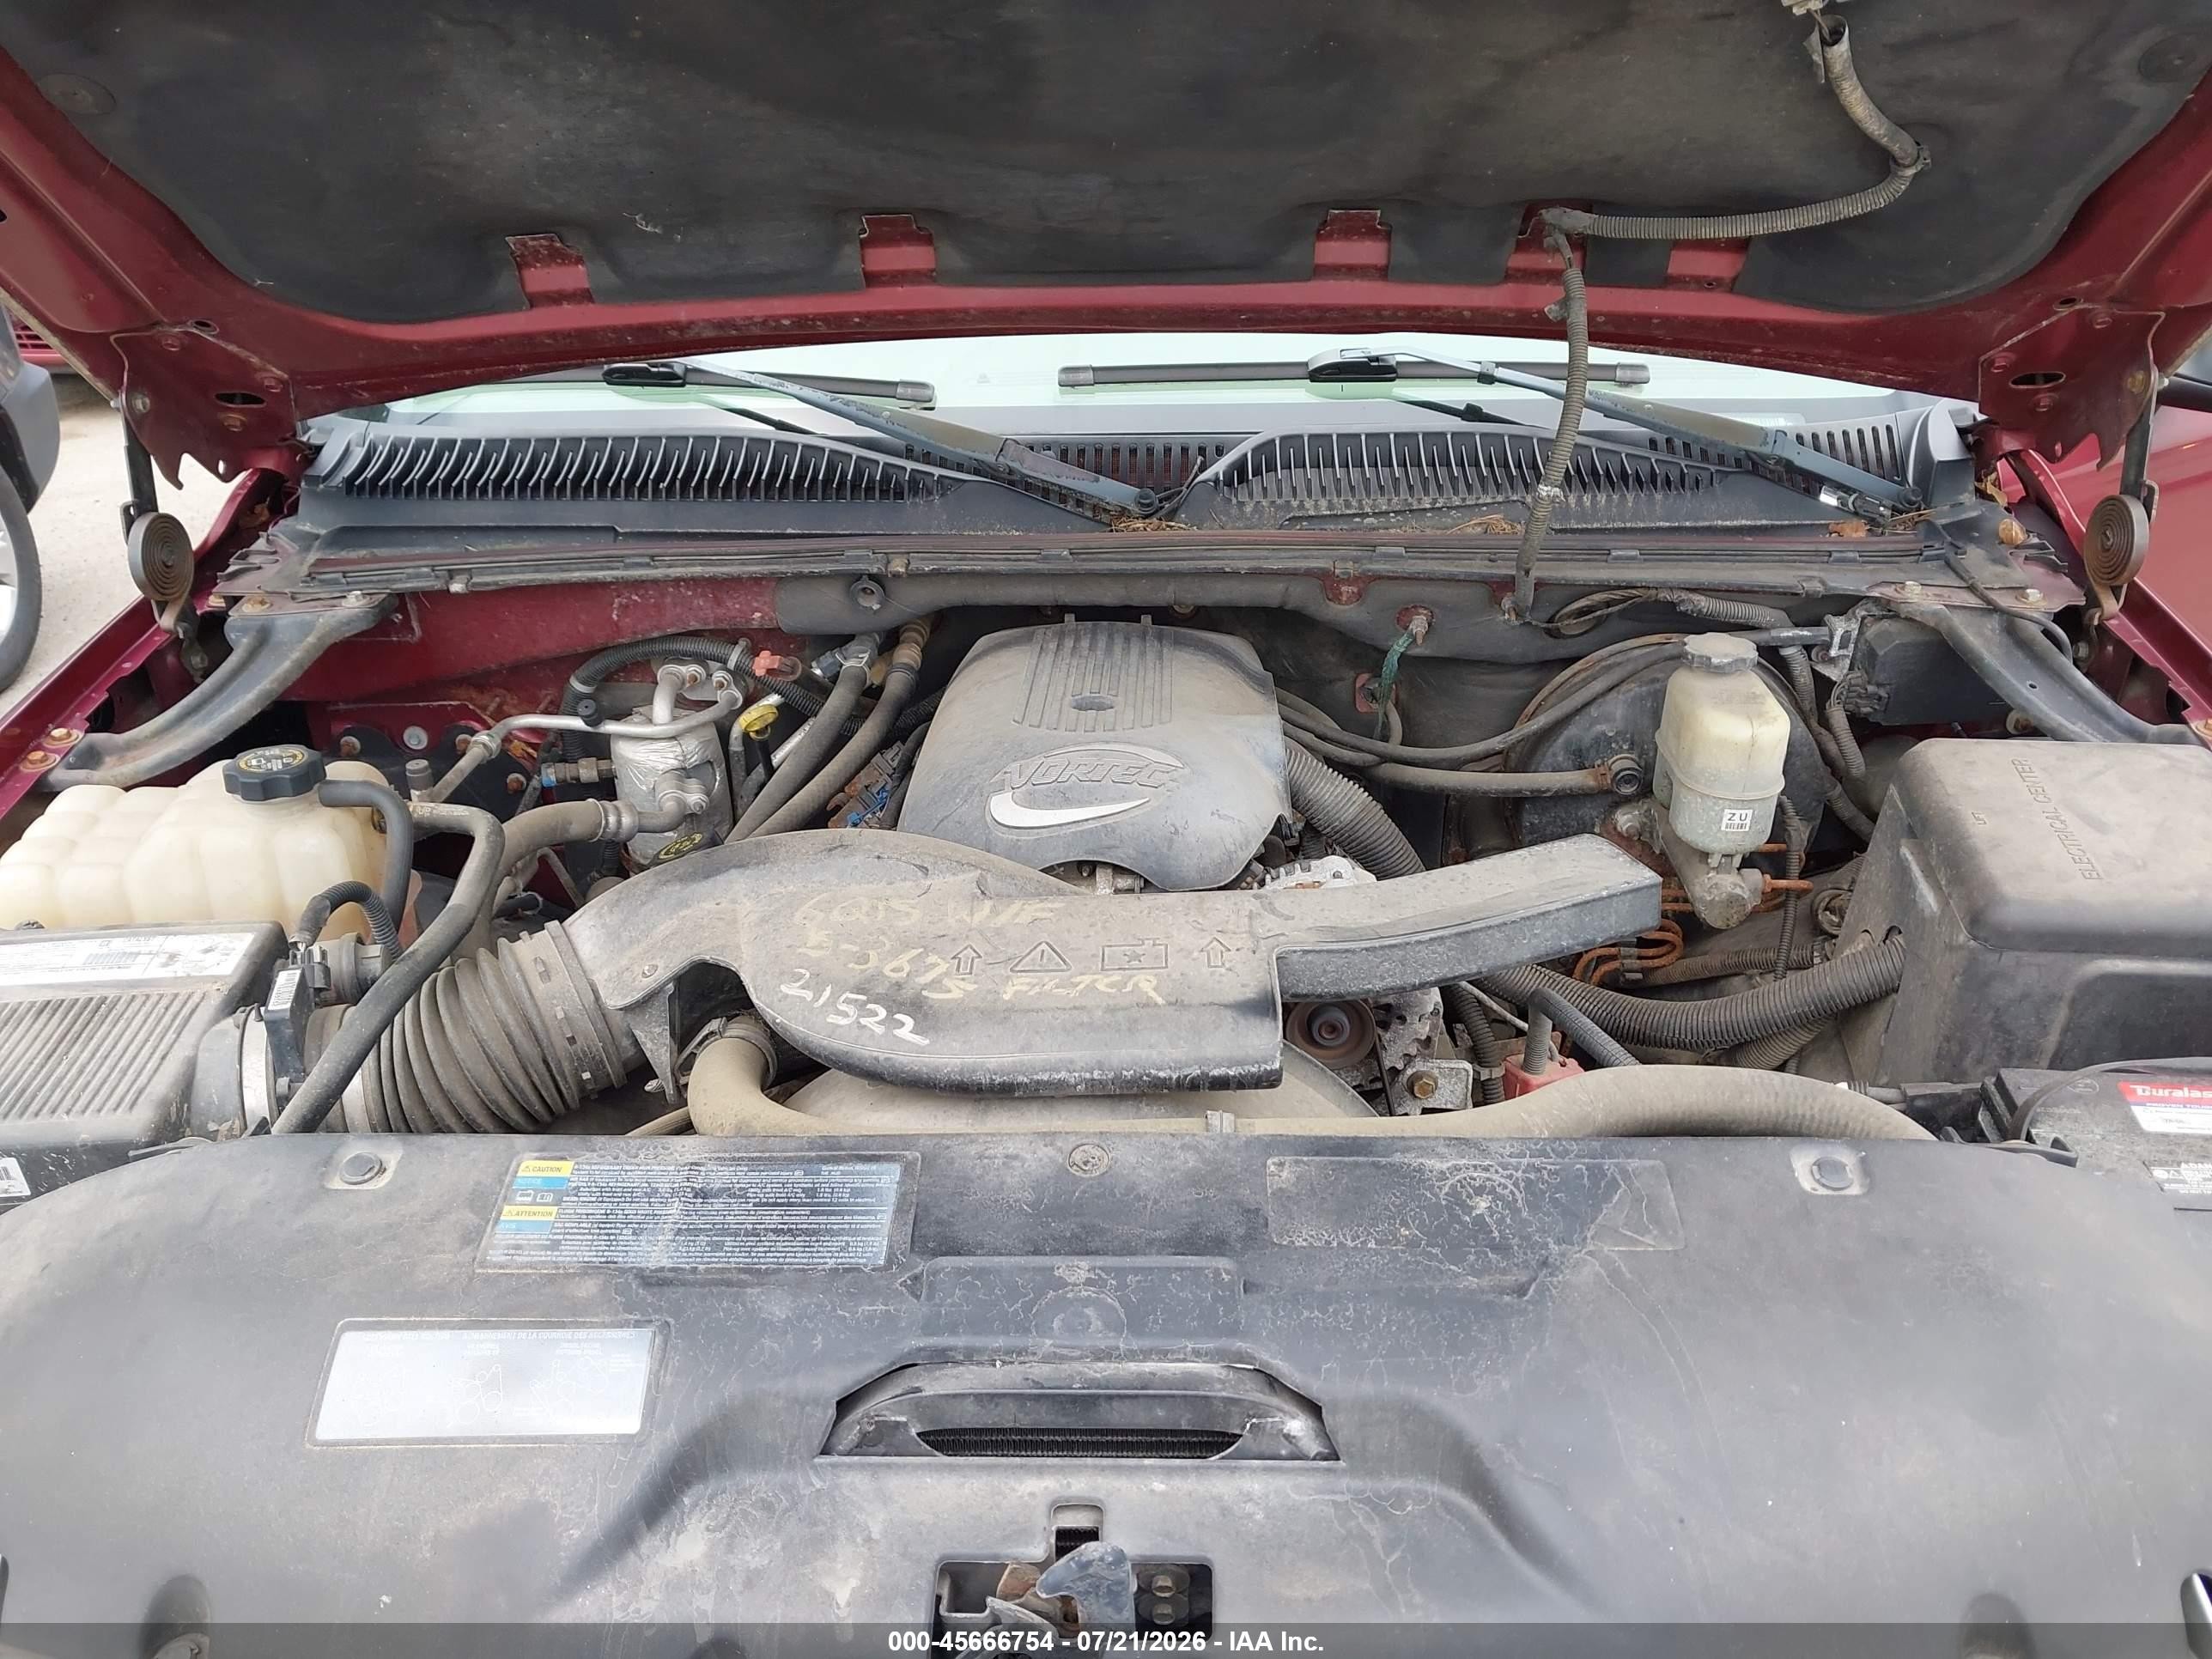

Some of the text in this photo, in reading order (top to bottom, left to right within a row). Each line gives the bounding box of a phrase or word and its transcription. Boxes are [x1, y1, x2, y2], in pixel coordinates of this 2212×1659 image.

[1002, 757, 1178, 790] VORTEC
[2011, 758, 2104, 880] ELECTRICAL CENTER
[780, 968, 930, 1046] 21522
